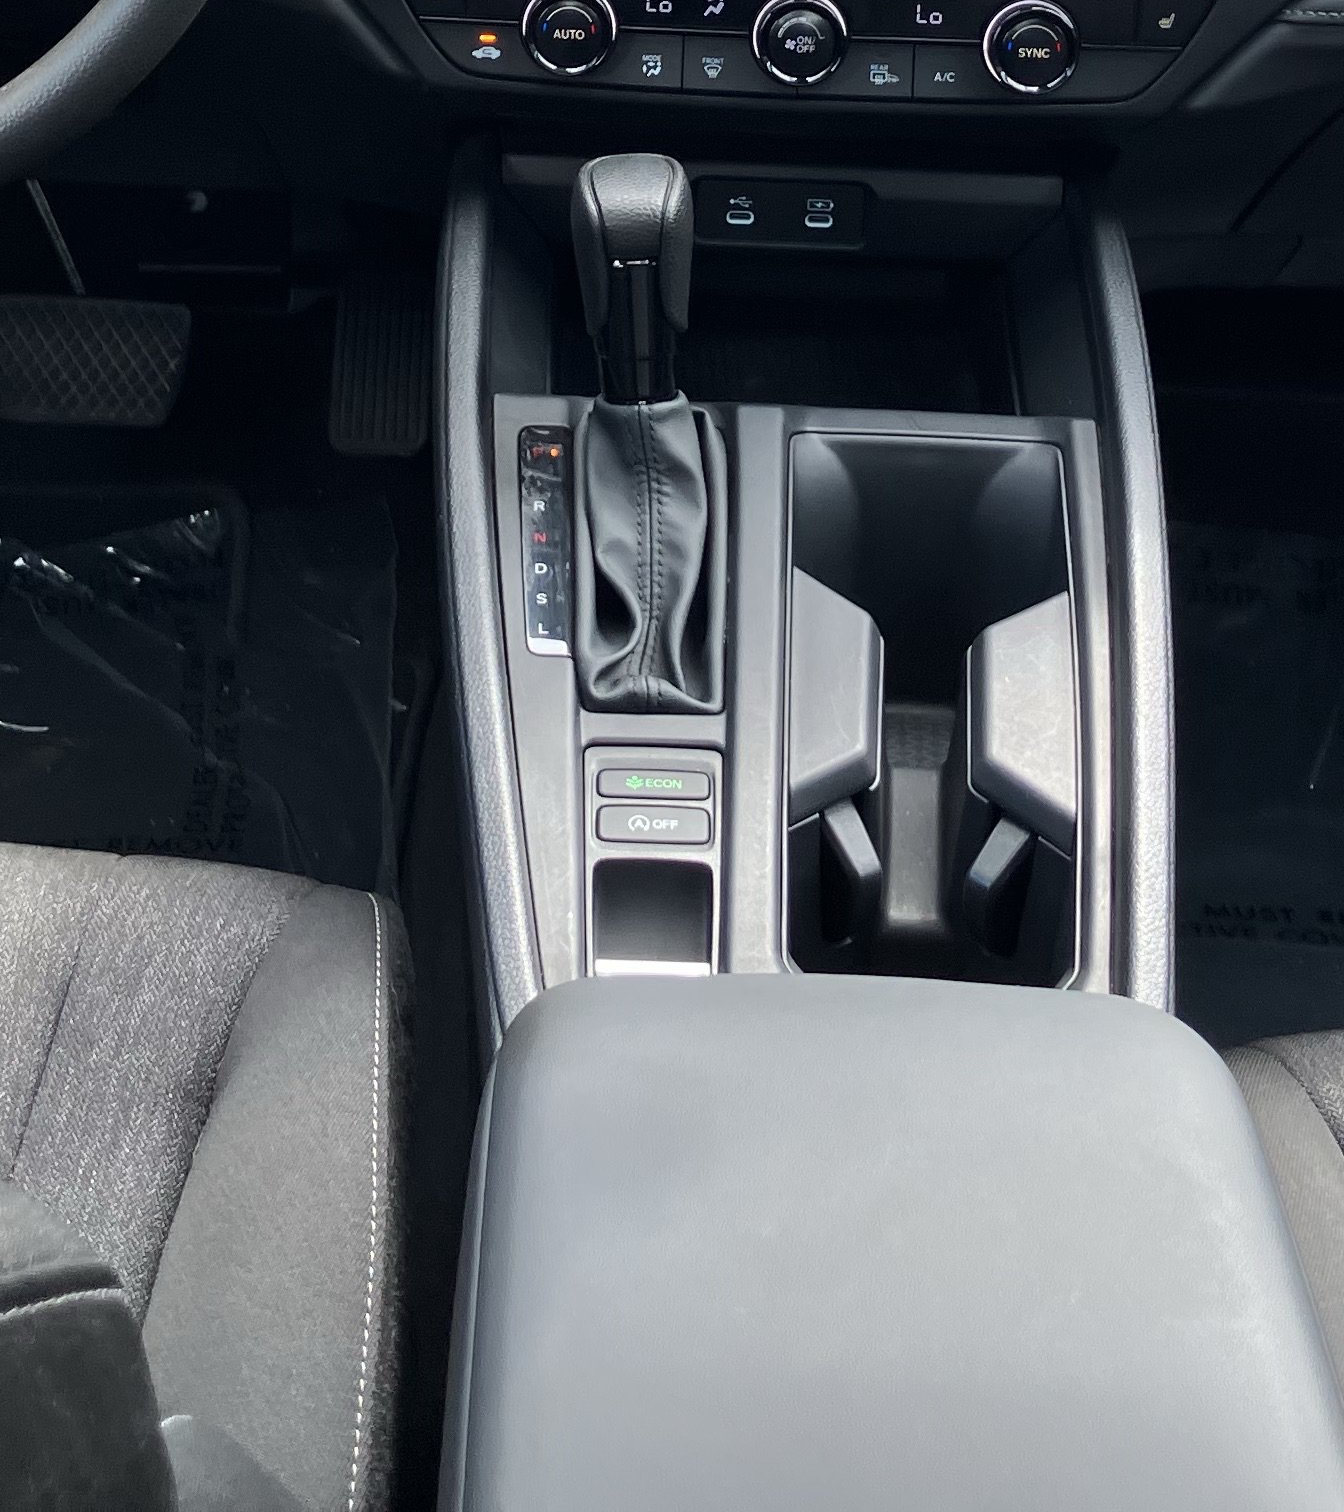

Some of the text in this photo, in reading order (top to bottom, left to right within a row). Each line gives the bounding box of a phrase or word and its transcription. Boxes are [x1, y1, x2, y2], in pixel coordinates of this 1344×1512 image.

[916, 3, 944, 25] Lo
[553, 29, 586, 41] AUTO
[796, 35, 816, 45] ON/
[796, 44, 816, 54] OFF
[1018, 47, 1051, 59] SYNC
[642, 54, 663, 62] MODE
[701, 56, 725, 65] FRONT
[870, 63, 889, 71] REAR
[933, 71, 956, 83] A/C
[533, 501, 546, 512] R
[533, 532, 547, 543] N
[535, 562, 548, 575] D
[536, 593, 548, 605] S
[538, 623, 549, 635] L
[645, 778, 682, 789] ECON
[652, 819, 679, 830] OFF
